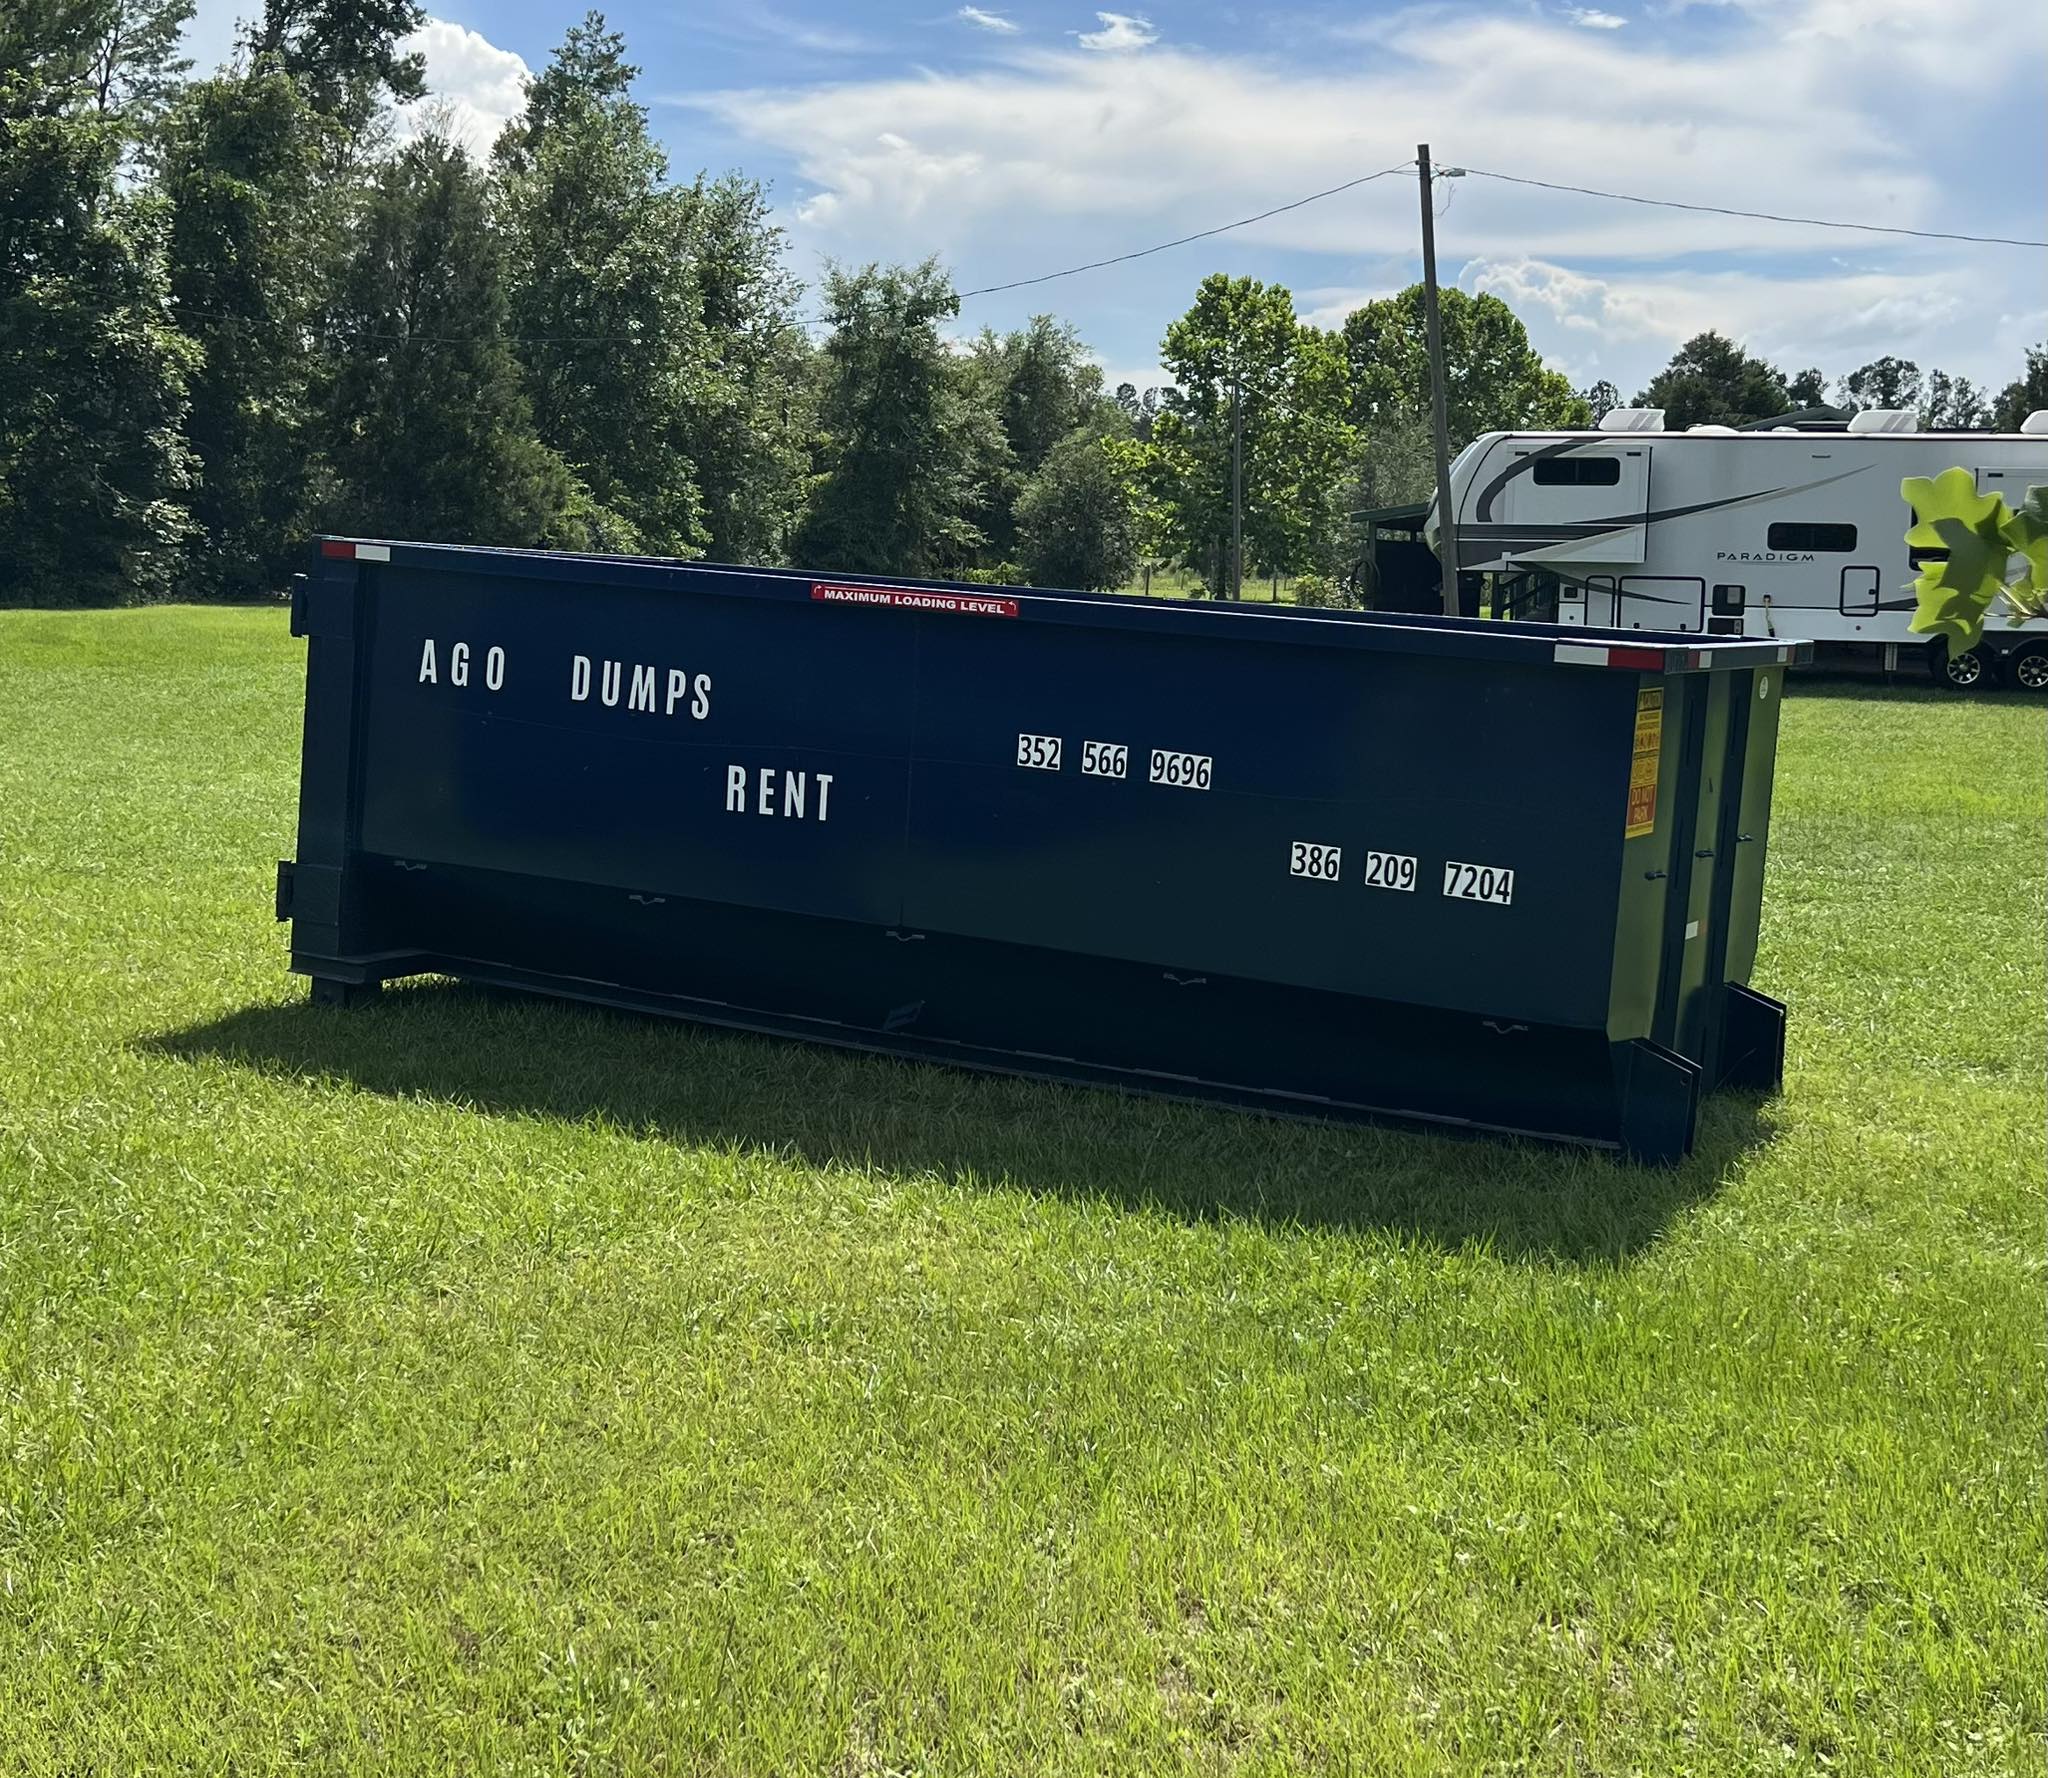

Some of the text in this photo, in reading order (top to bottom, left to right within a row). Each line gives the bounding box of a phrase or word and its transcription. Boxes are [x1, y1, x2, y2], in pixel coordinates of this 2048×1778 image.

[1717, 552, 1816, 562] PARADIGM
[824, 588, 1005, 616] MAXIMUM LOADING LEVEL
[420, 640, 711, 719] AGO DUMPS
[1018, 736, 1210, 788] 352 566 9696
[727, 765, 832, 820] RENT
[1292, 844, 1511, 904] 386 209 7204
